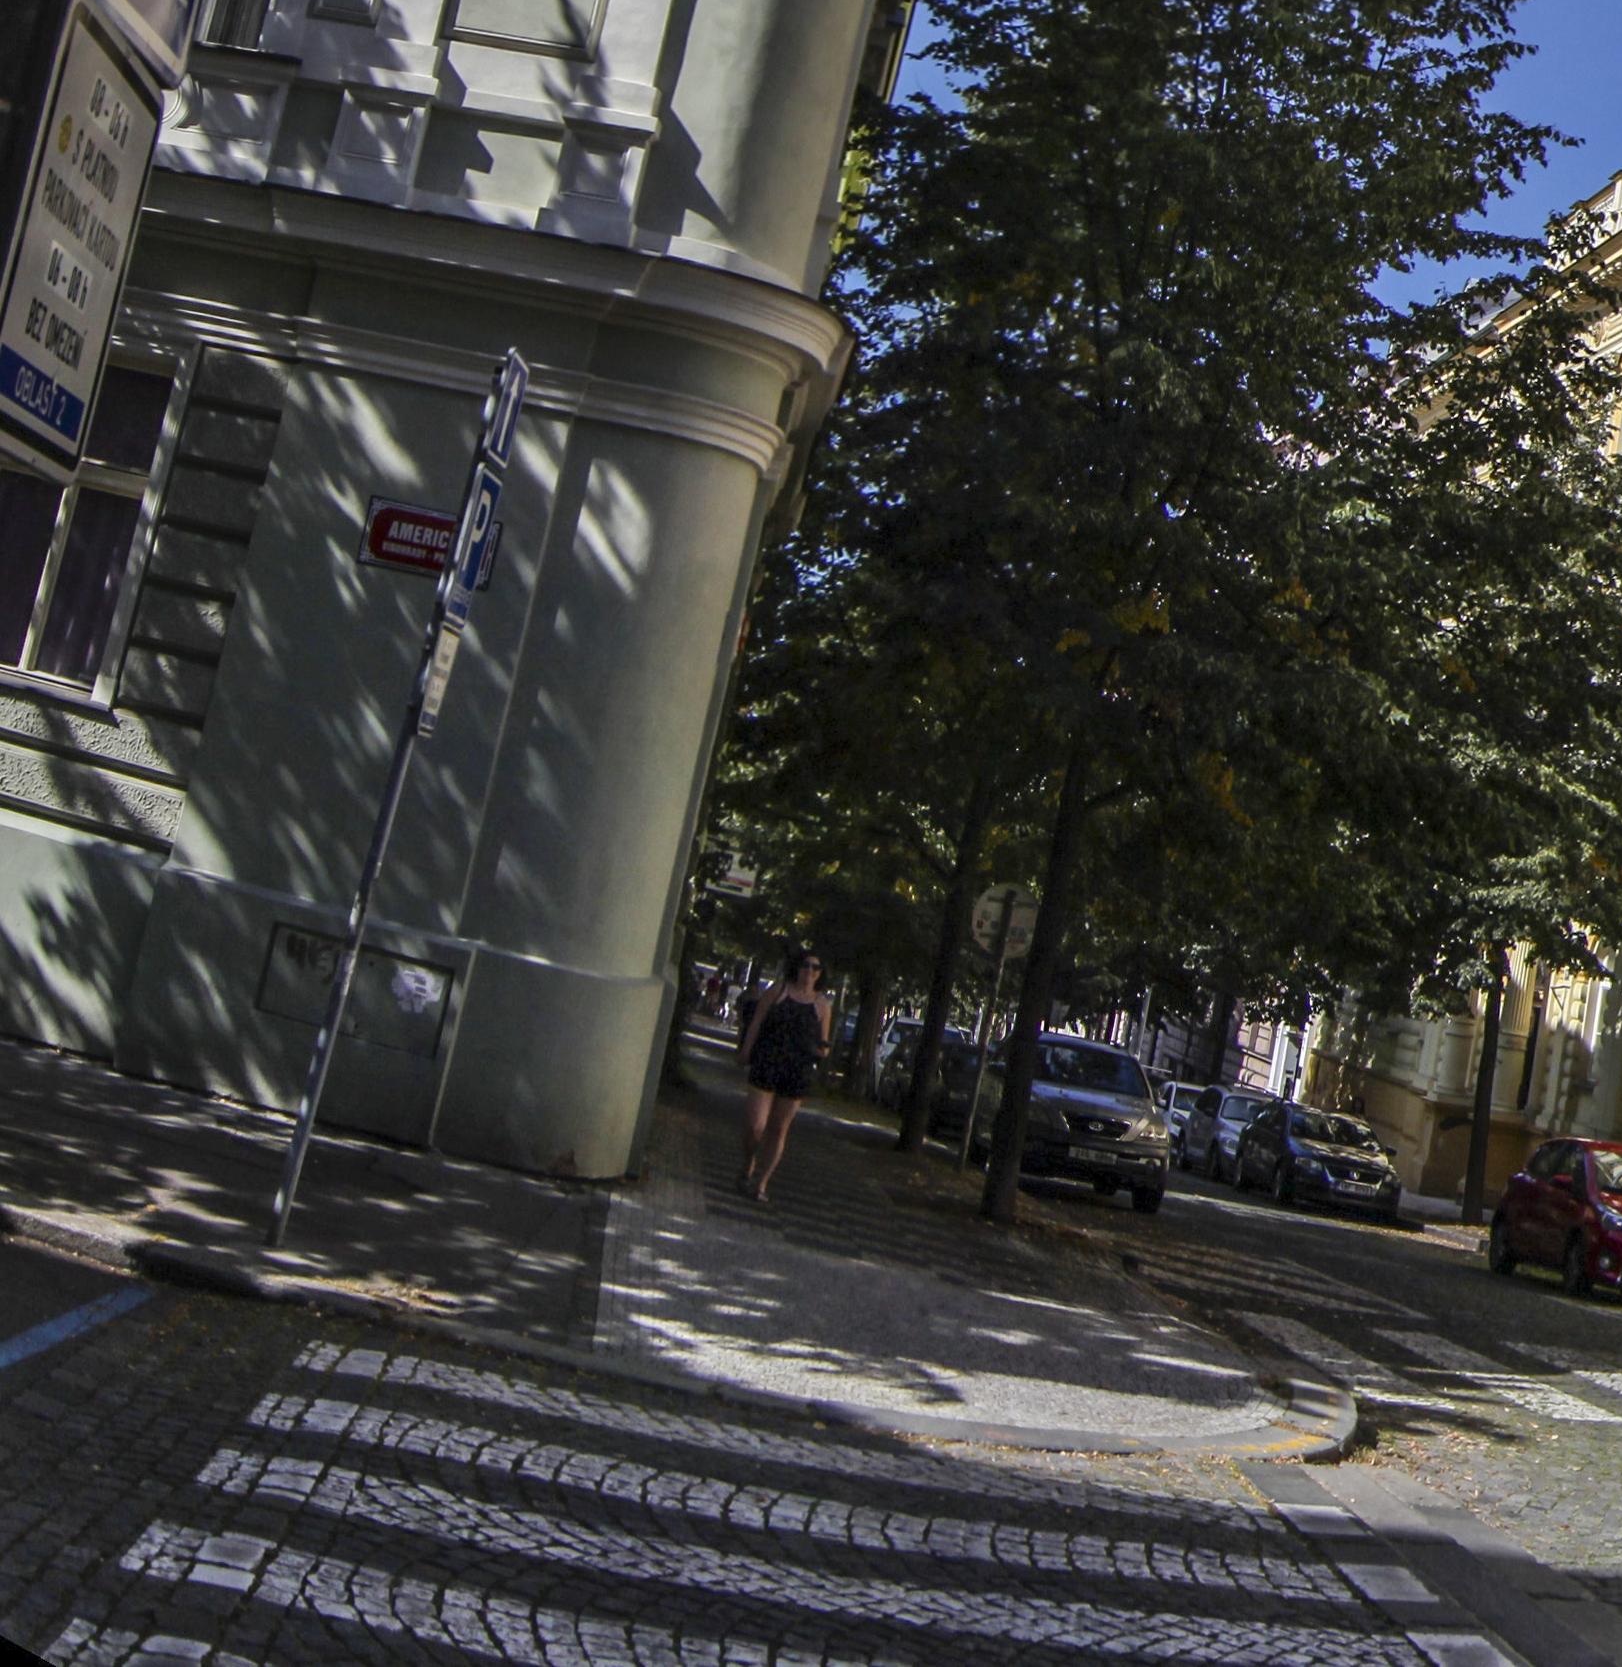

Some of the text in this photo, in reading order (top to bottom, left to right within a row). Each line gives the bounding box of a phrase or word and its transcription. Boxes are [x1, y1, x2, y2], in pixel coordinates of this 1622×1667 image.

[72, 128, 120, 204] S PLATNOU
[47, 247, 63, 287] 06
[25, 296, 48, 344] BEZ
[55, 395, 67, 426] 2
[387, 520, 453, 549] AMERIC
[462, 489, 492, 572] P
